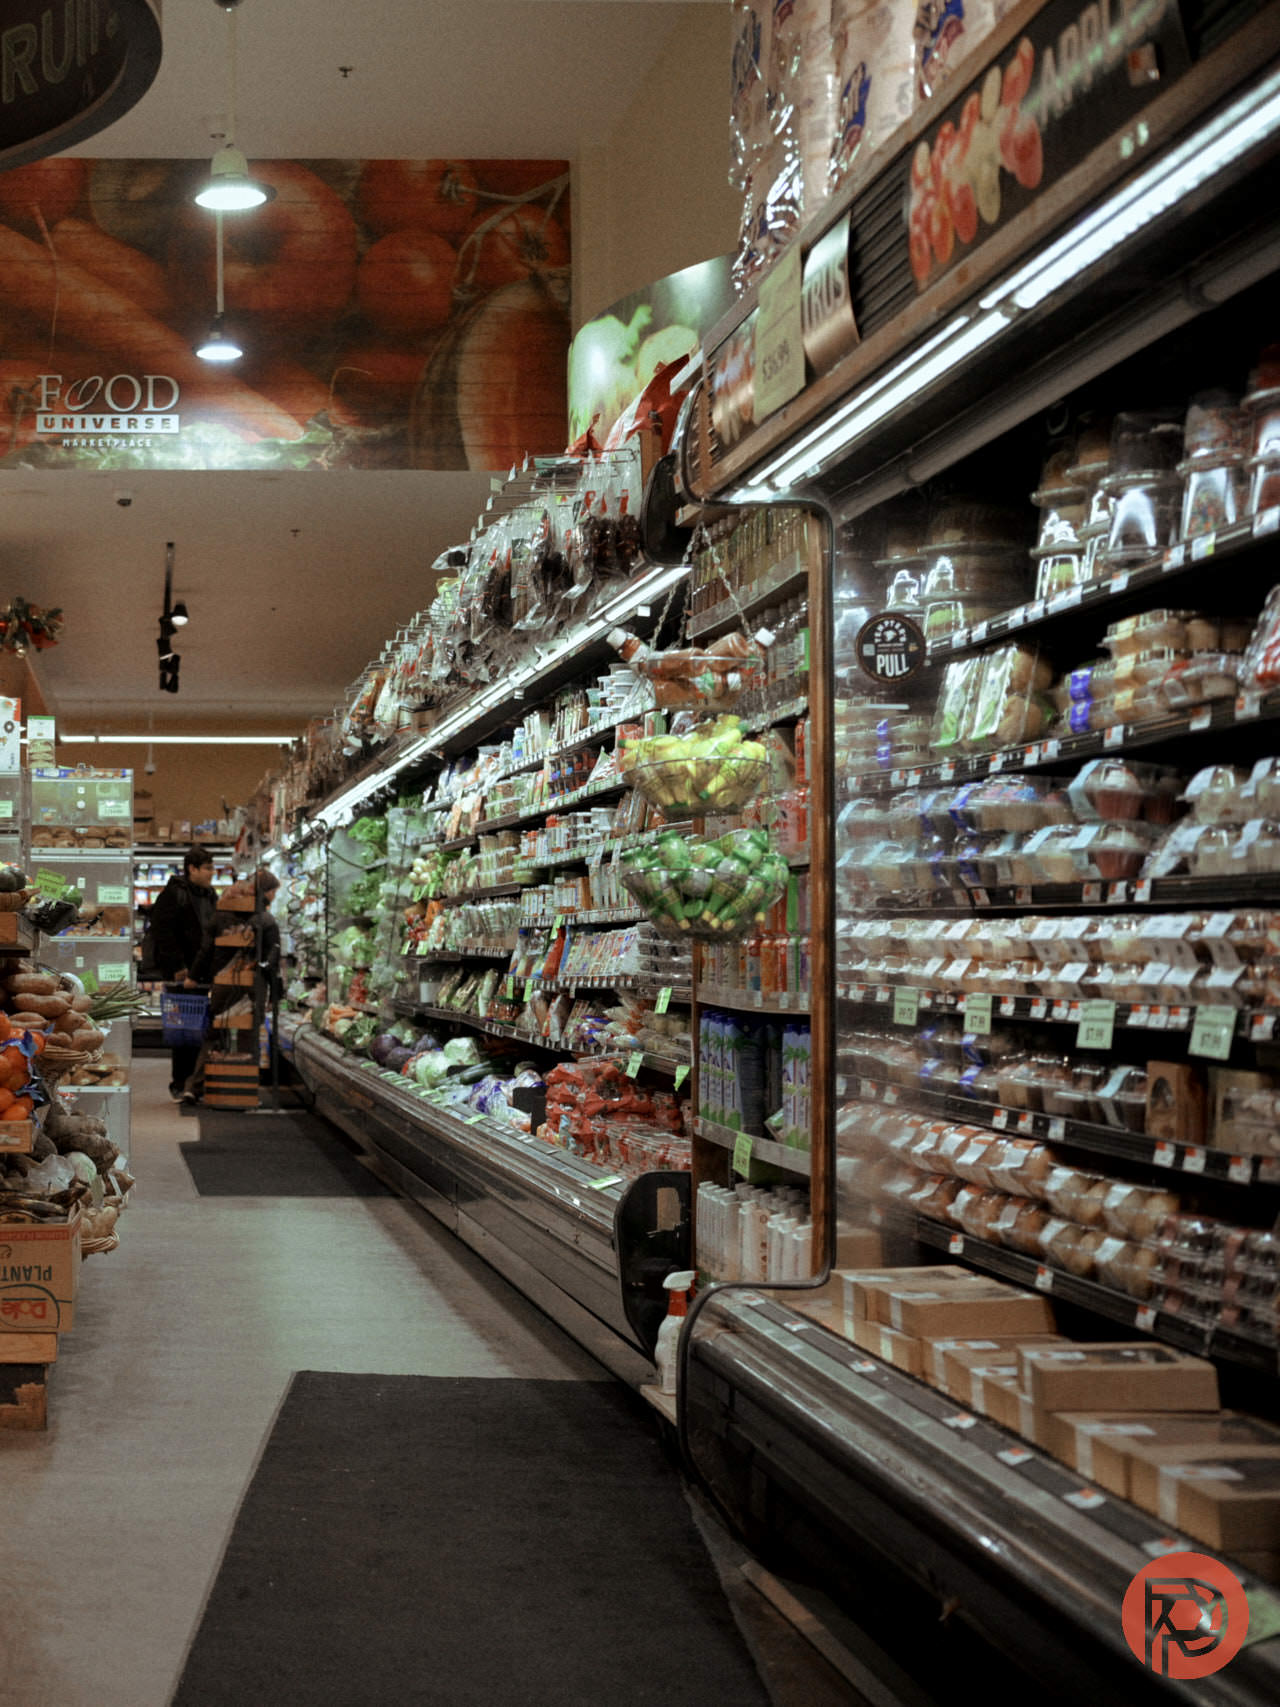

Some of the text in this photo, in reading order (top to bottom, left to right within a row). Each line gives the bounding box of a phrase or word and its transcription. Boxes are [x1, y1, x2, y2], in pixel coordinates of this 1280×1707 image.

[36, 374, 180, 412] FOOD
[43, 416, 172, 430] UNIVERSE
[62, 438, 152, 448] MARKETPLACE
[876, 653, 910, 677] PULL
[1, 1301, 47, 1320] Dole
